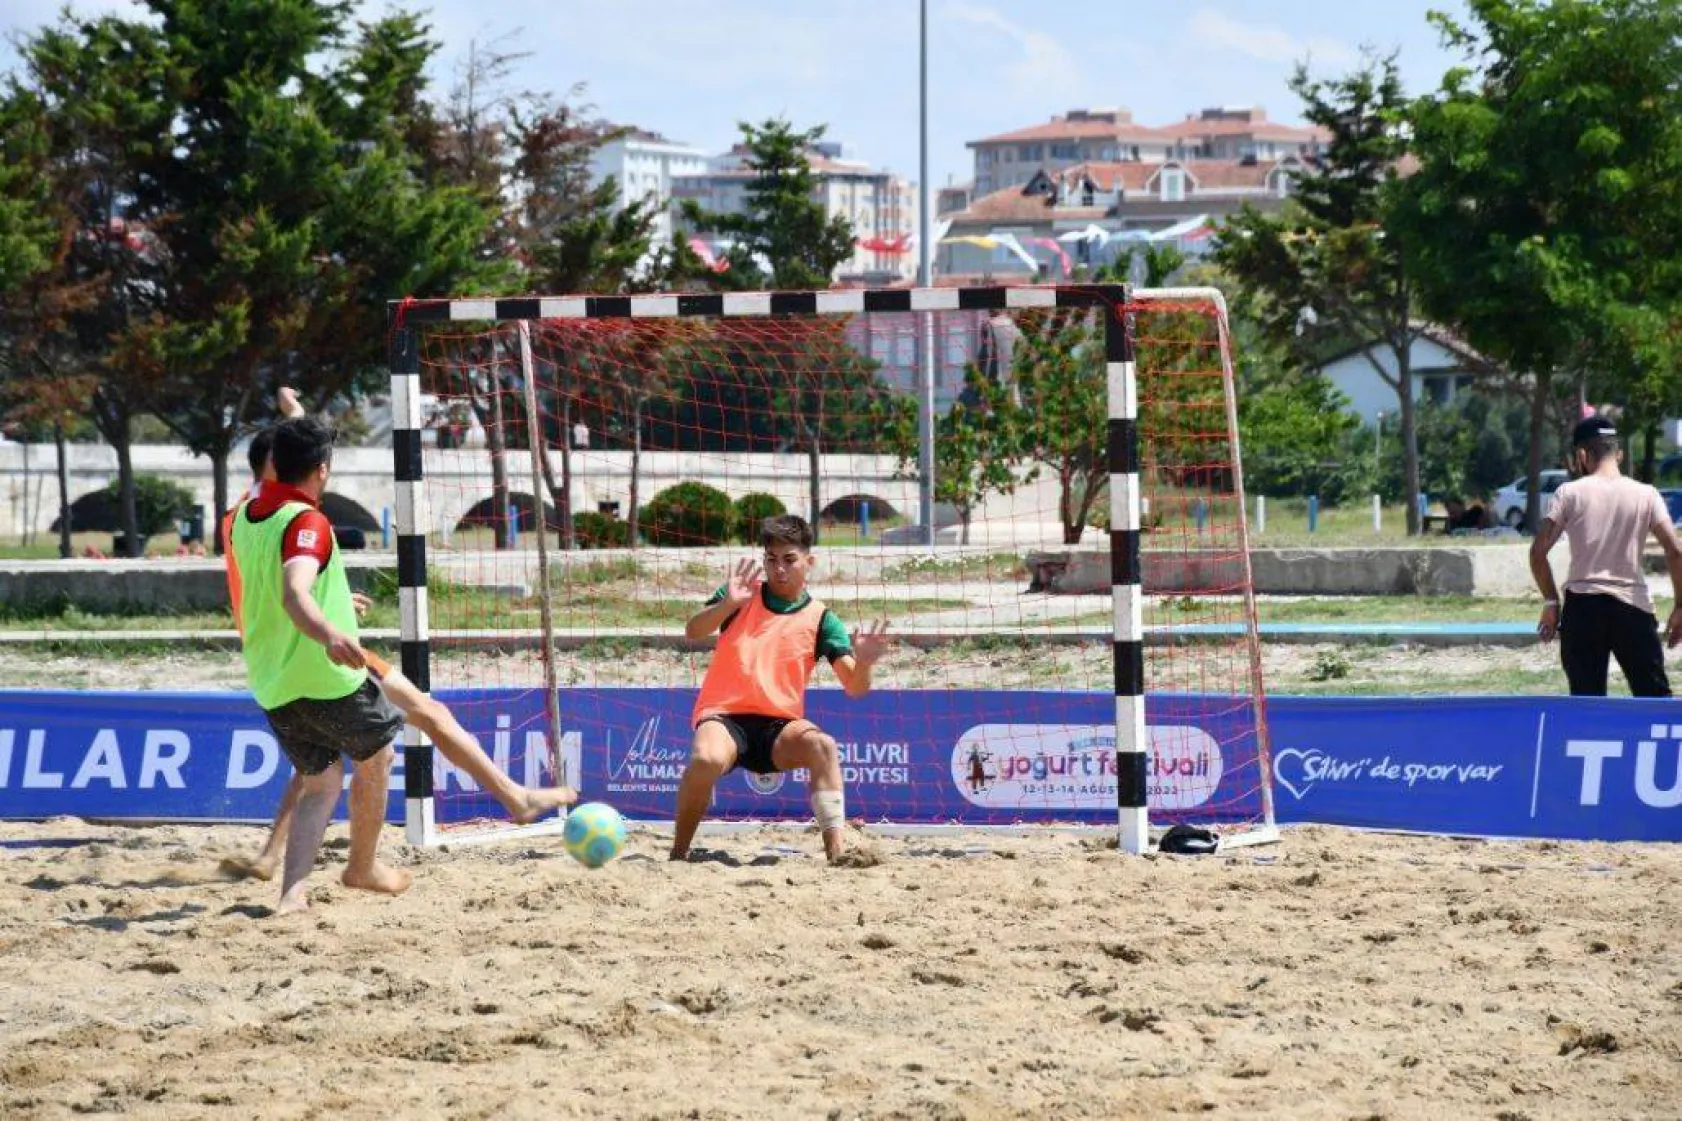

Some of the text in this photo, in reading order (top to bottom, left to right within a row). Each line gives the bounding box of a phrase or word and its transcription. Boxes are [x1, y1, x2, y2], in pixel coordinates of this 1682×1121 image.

[626, 764, 687, 779] YILMAZ
[791, 767, 909, 783] BDİYESİ
[1097, 750, 1209, 777] feivali
[1402, 763, 1457, 788] spor
[1458, 762, 1504, 783] var
[1566, 724, 1682, 808] TÜ
